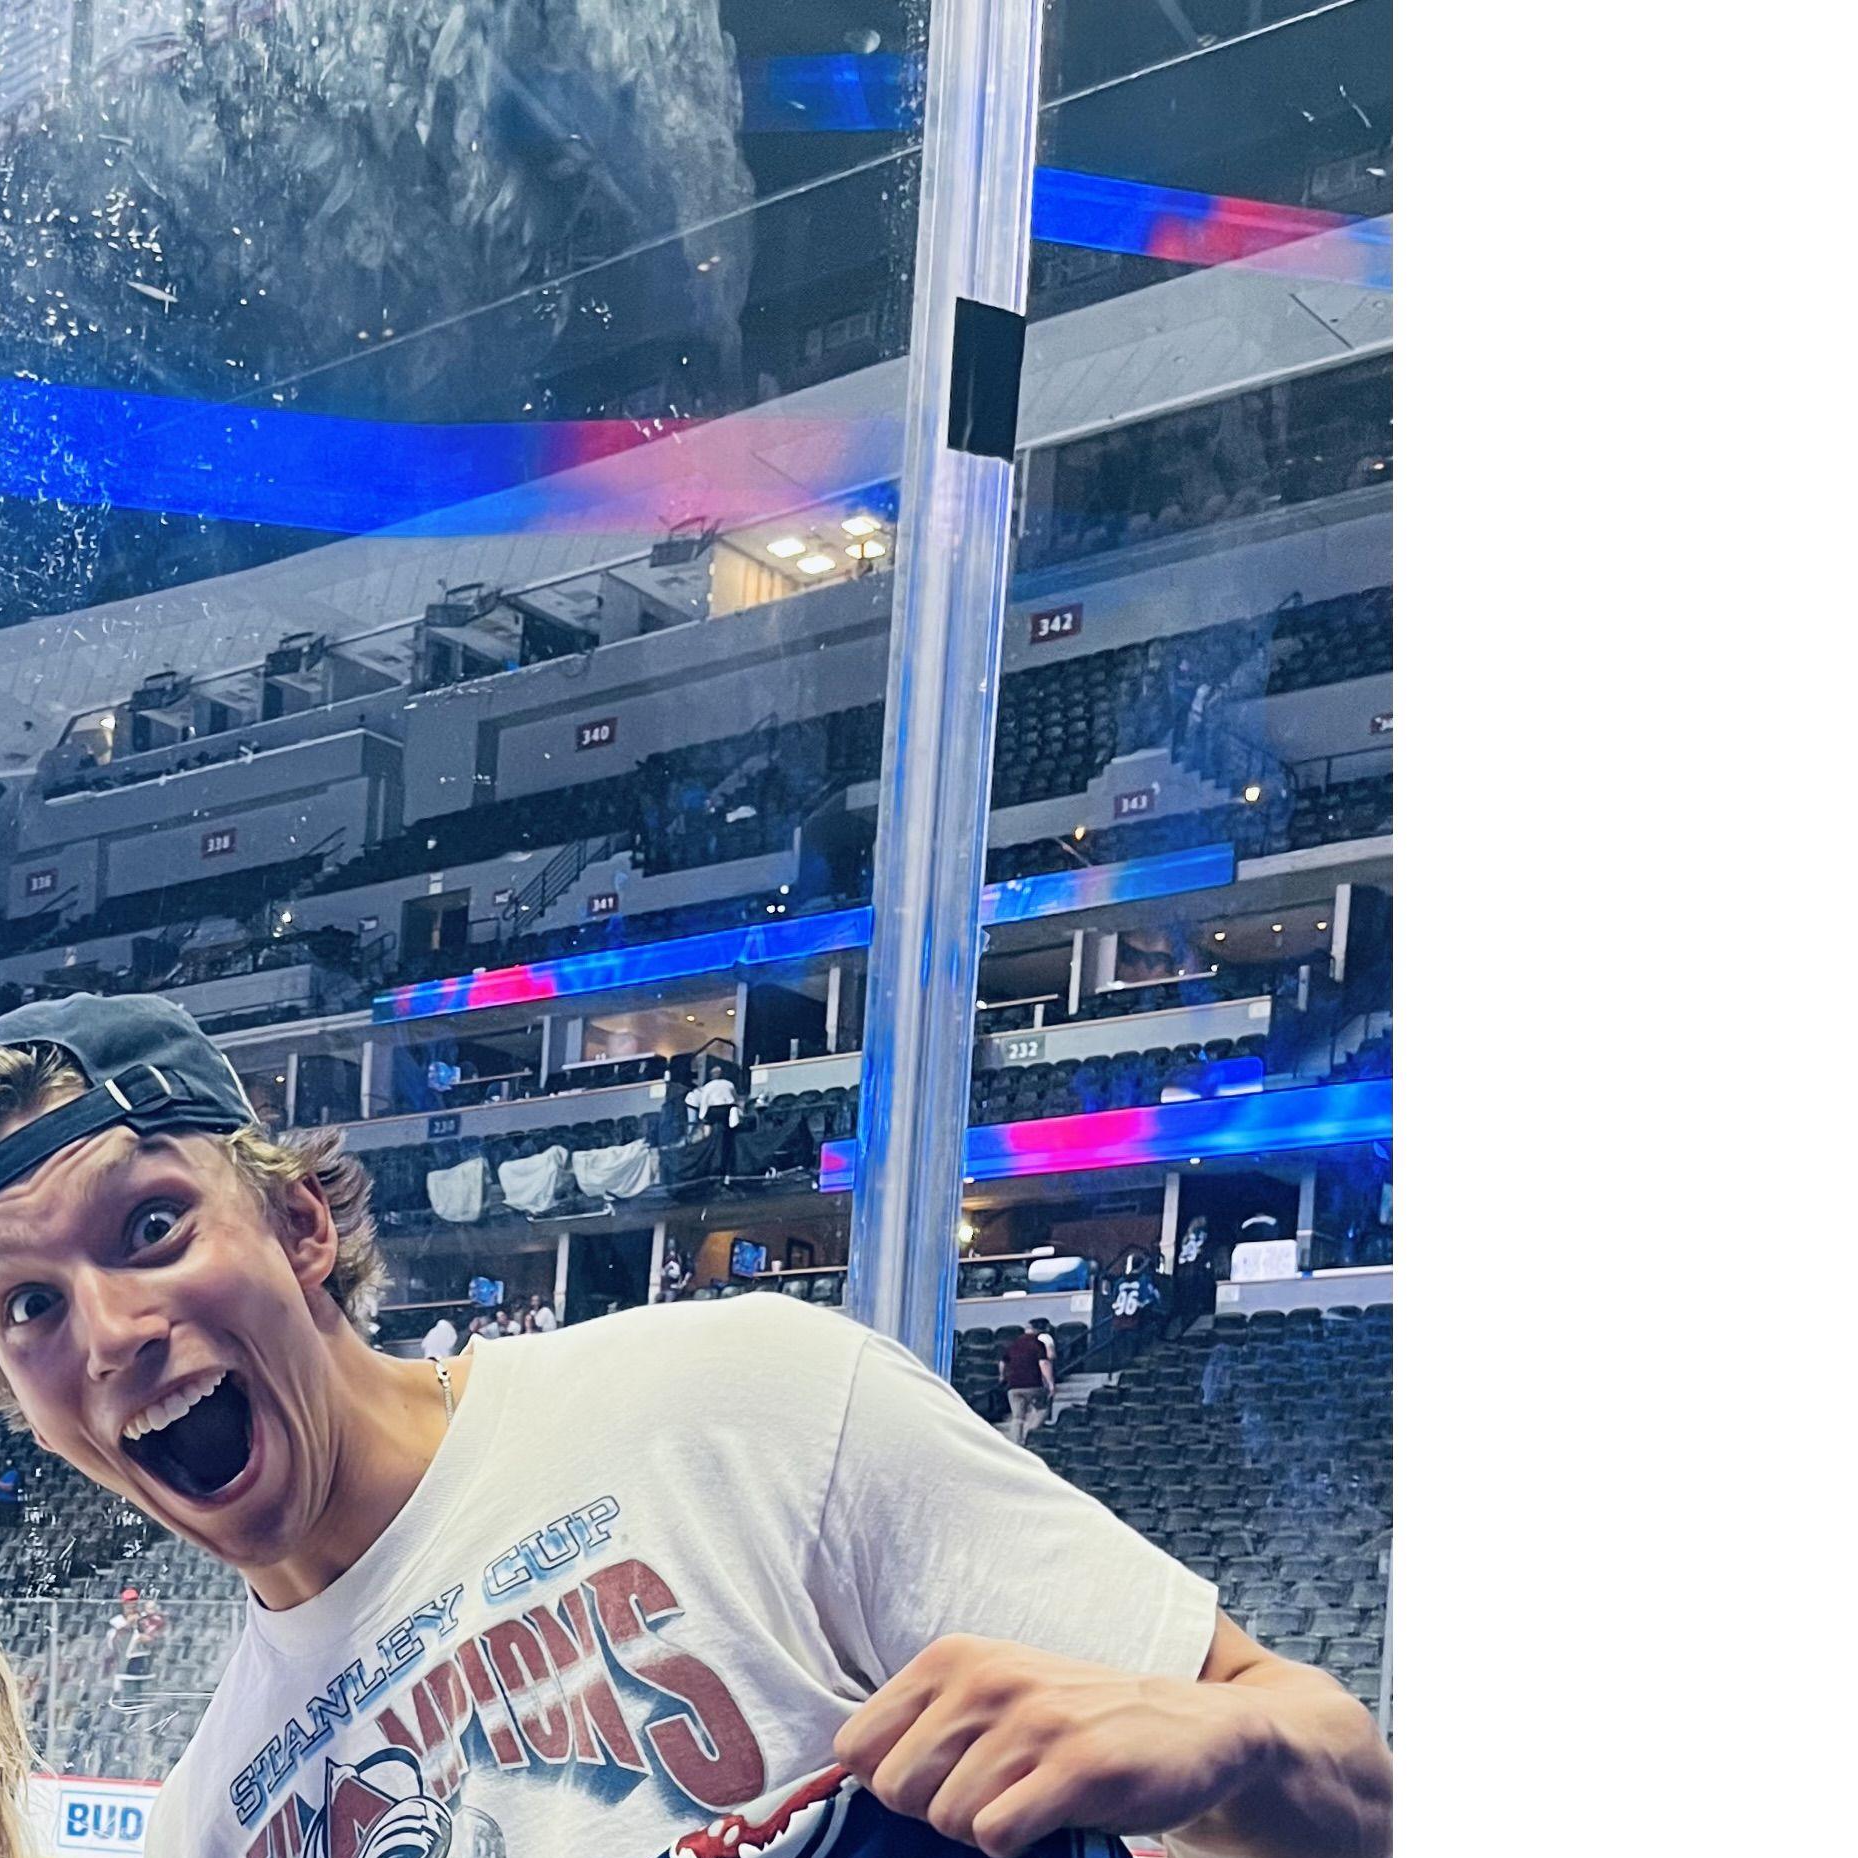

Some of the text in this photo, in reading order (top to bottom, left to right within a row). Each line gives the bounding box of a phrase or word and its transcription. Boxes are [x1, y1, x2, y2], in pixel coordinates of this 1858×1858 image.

[1038, 612, 1073, 636] 342
[581, 725, 611, 746] 340
[1008, 1041, 1039, 1060] 232
[1112, 1290, 1139, 1316] 96
[229, 1495, 619, 1828] STANLEY CUP
[66, 1802, 144, 1841] BUD
